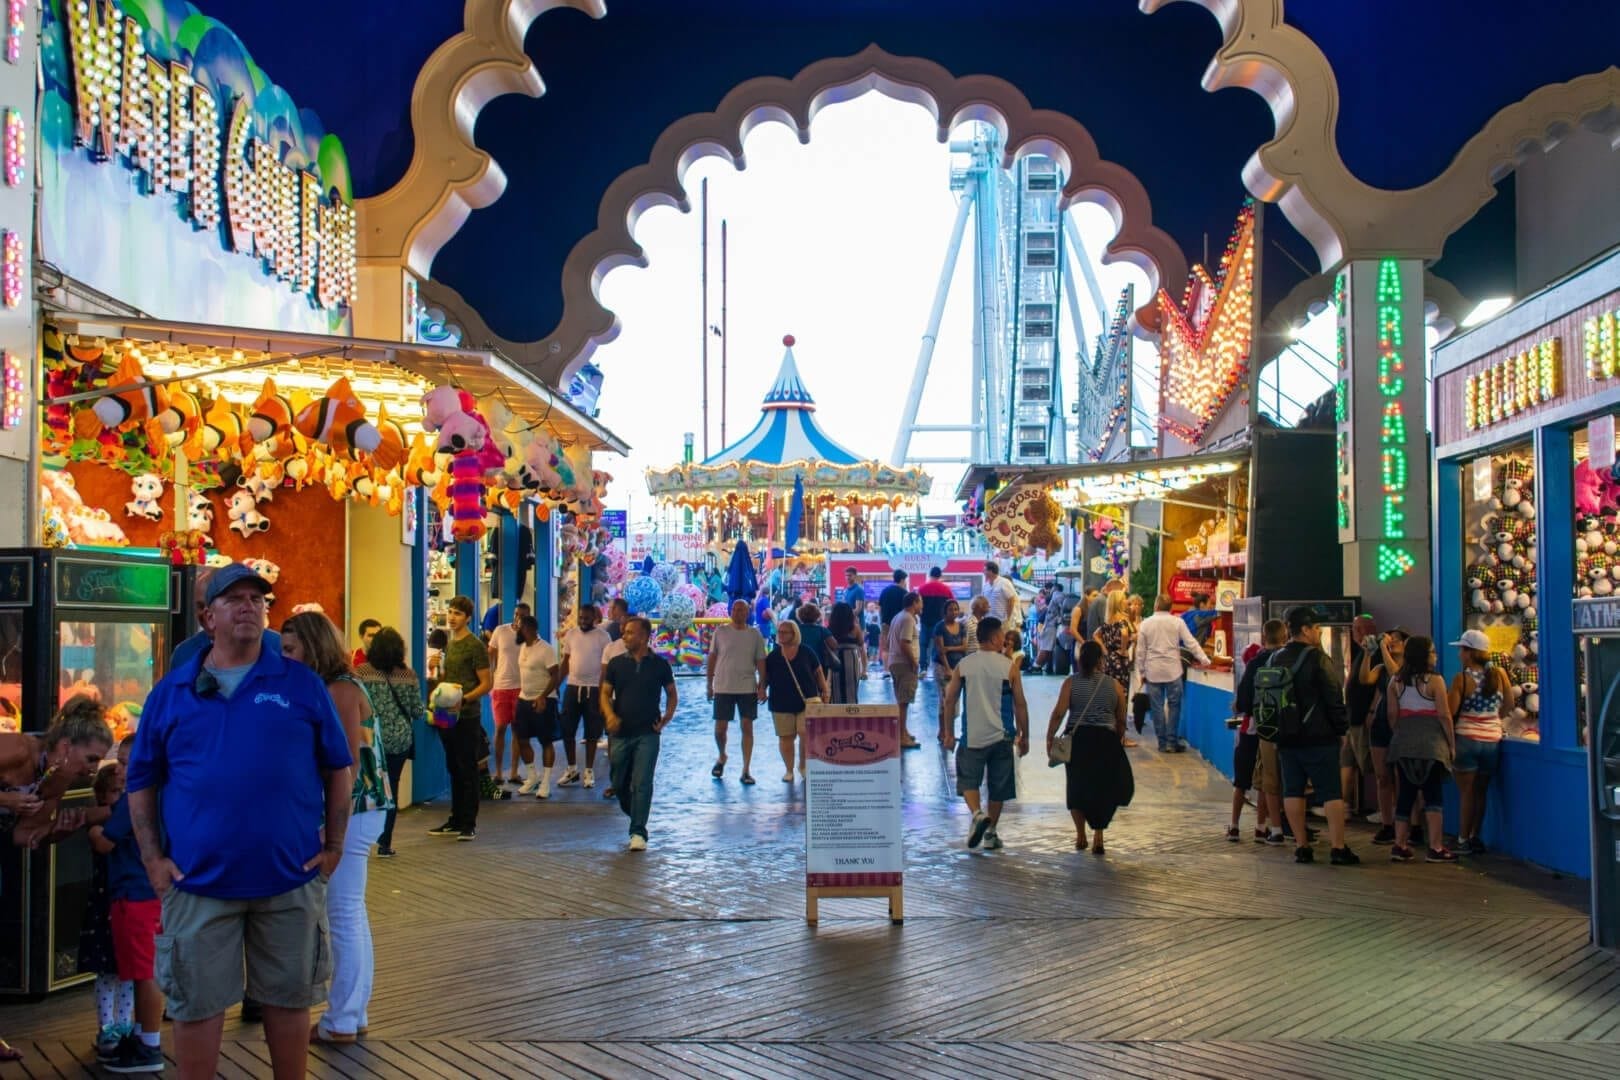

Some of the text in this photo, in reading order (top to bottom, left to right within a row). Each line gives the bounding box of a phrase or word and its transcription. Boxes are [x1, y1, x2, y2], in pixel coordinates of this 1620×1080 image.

[1378, 259, 1406, 539] ARCADE
[1007, 490, 1046, 518] CROSS
[1580, 602, 1618, 627] ATM
[835, 857, 875, 865] THANK YOU
